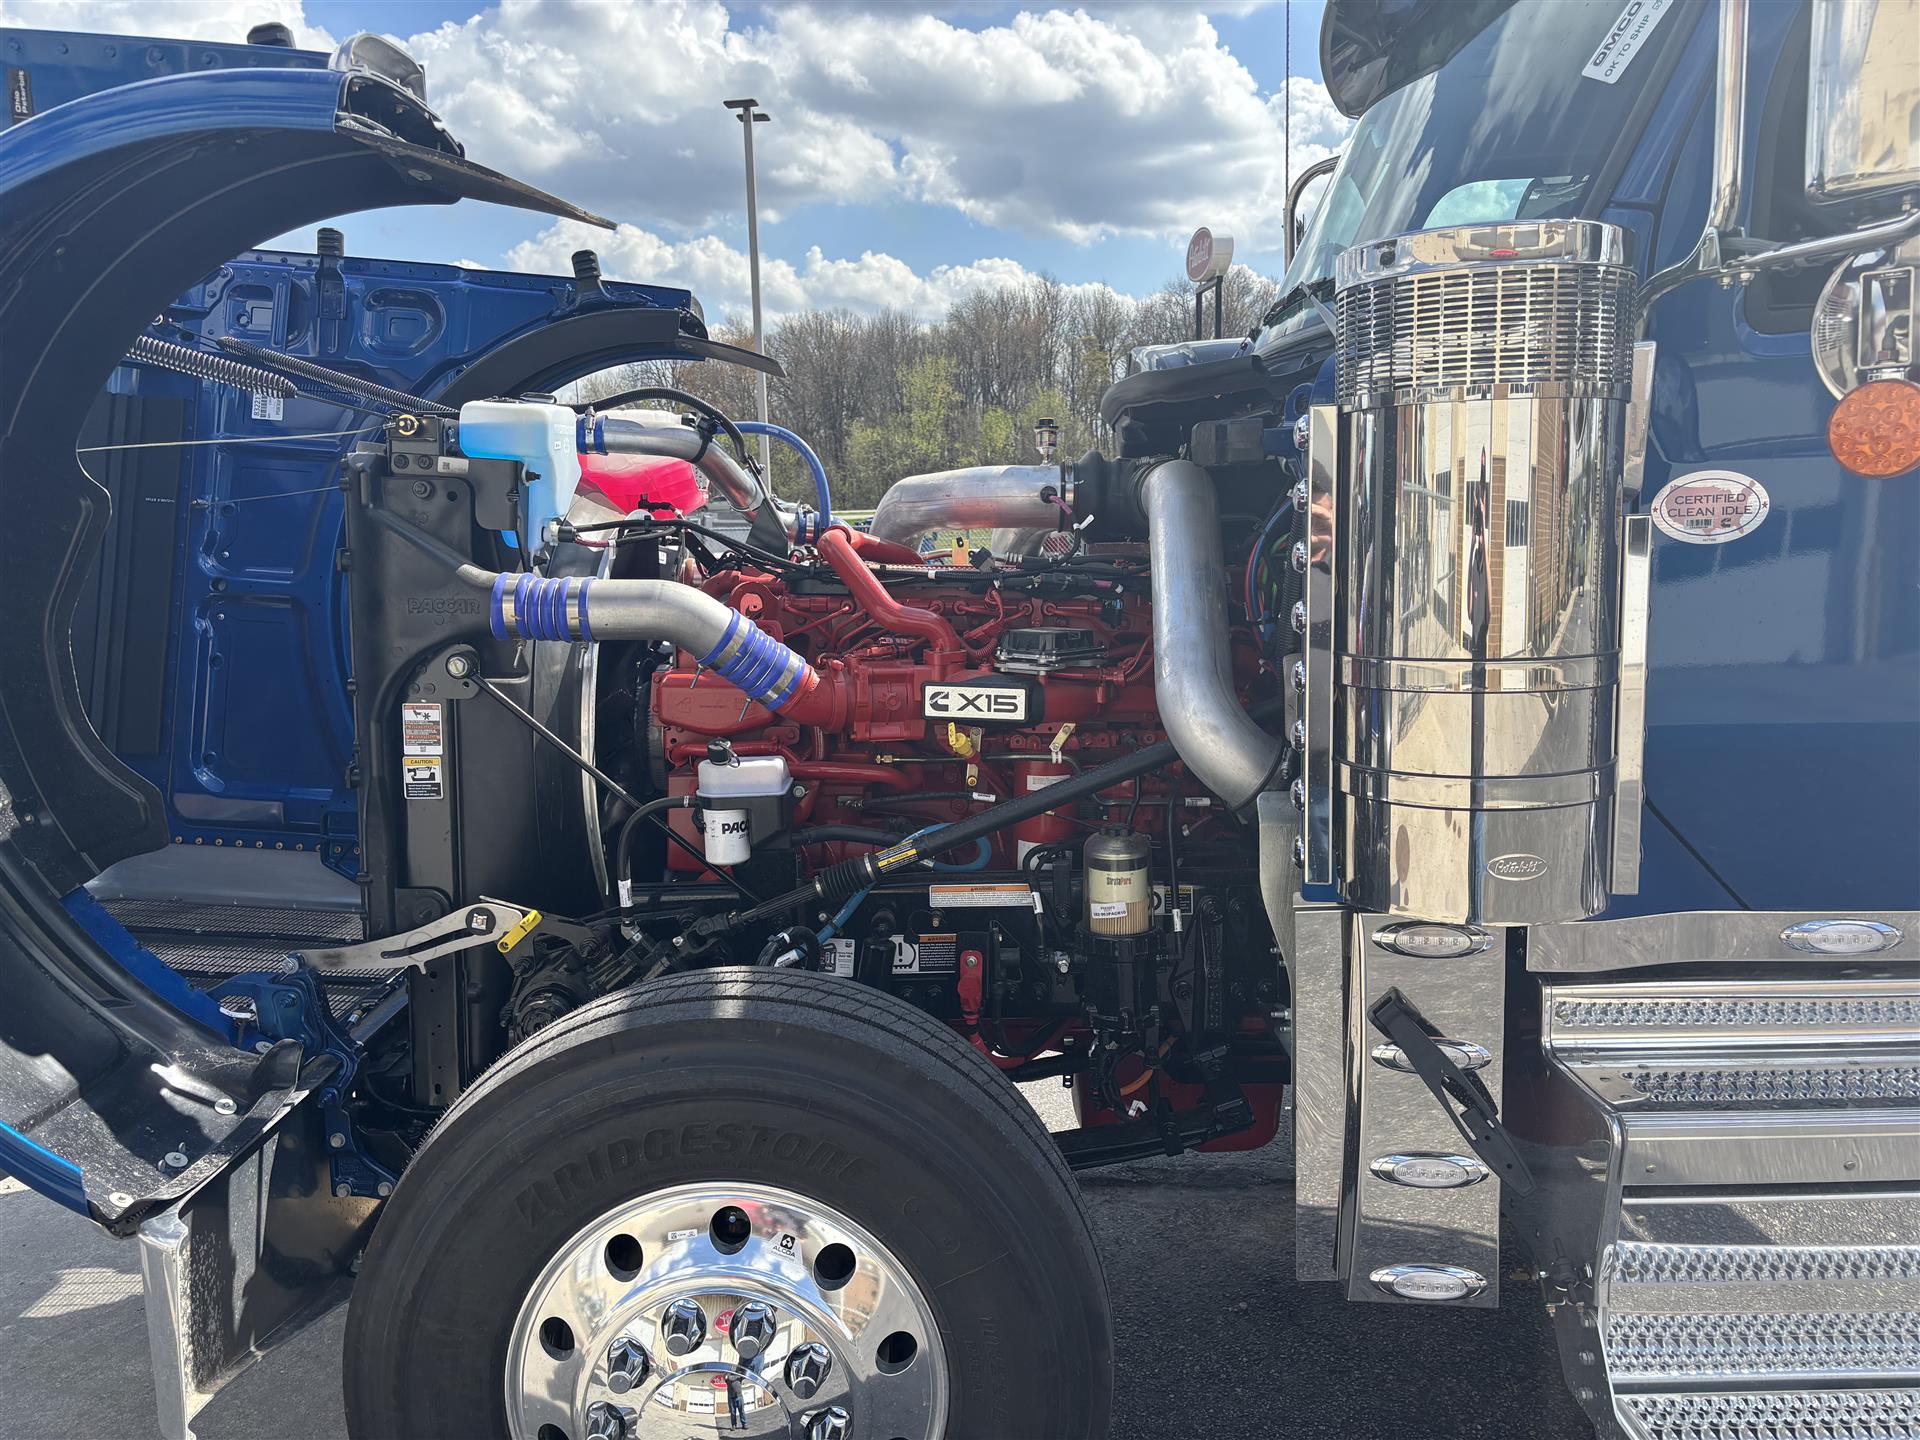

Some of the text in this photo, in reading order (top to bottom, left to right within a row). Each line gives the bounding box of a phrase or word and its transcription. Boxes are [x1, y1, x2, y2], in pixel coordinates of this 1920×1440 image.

[1604, 15, 1650, 77] OK TO SHIP
[1674, 493, 1747, 505] CERTIFIED
[1668, 505, 1753, 518] CLEAN IDLE
[407, 598, 480, 614] PACCAR
[956, 693, 1019, 714] X15
[772, 1245, 796, 1258] ALCOA
